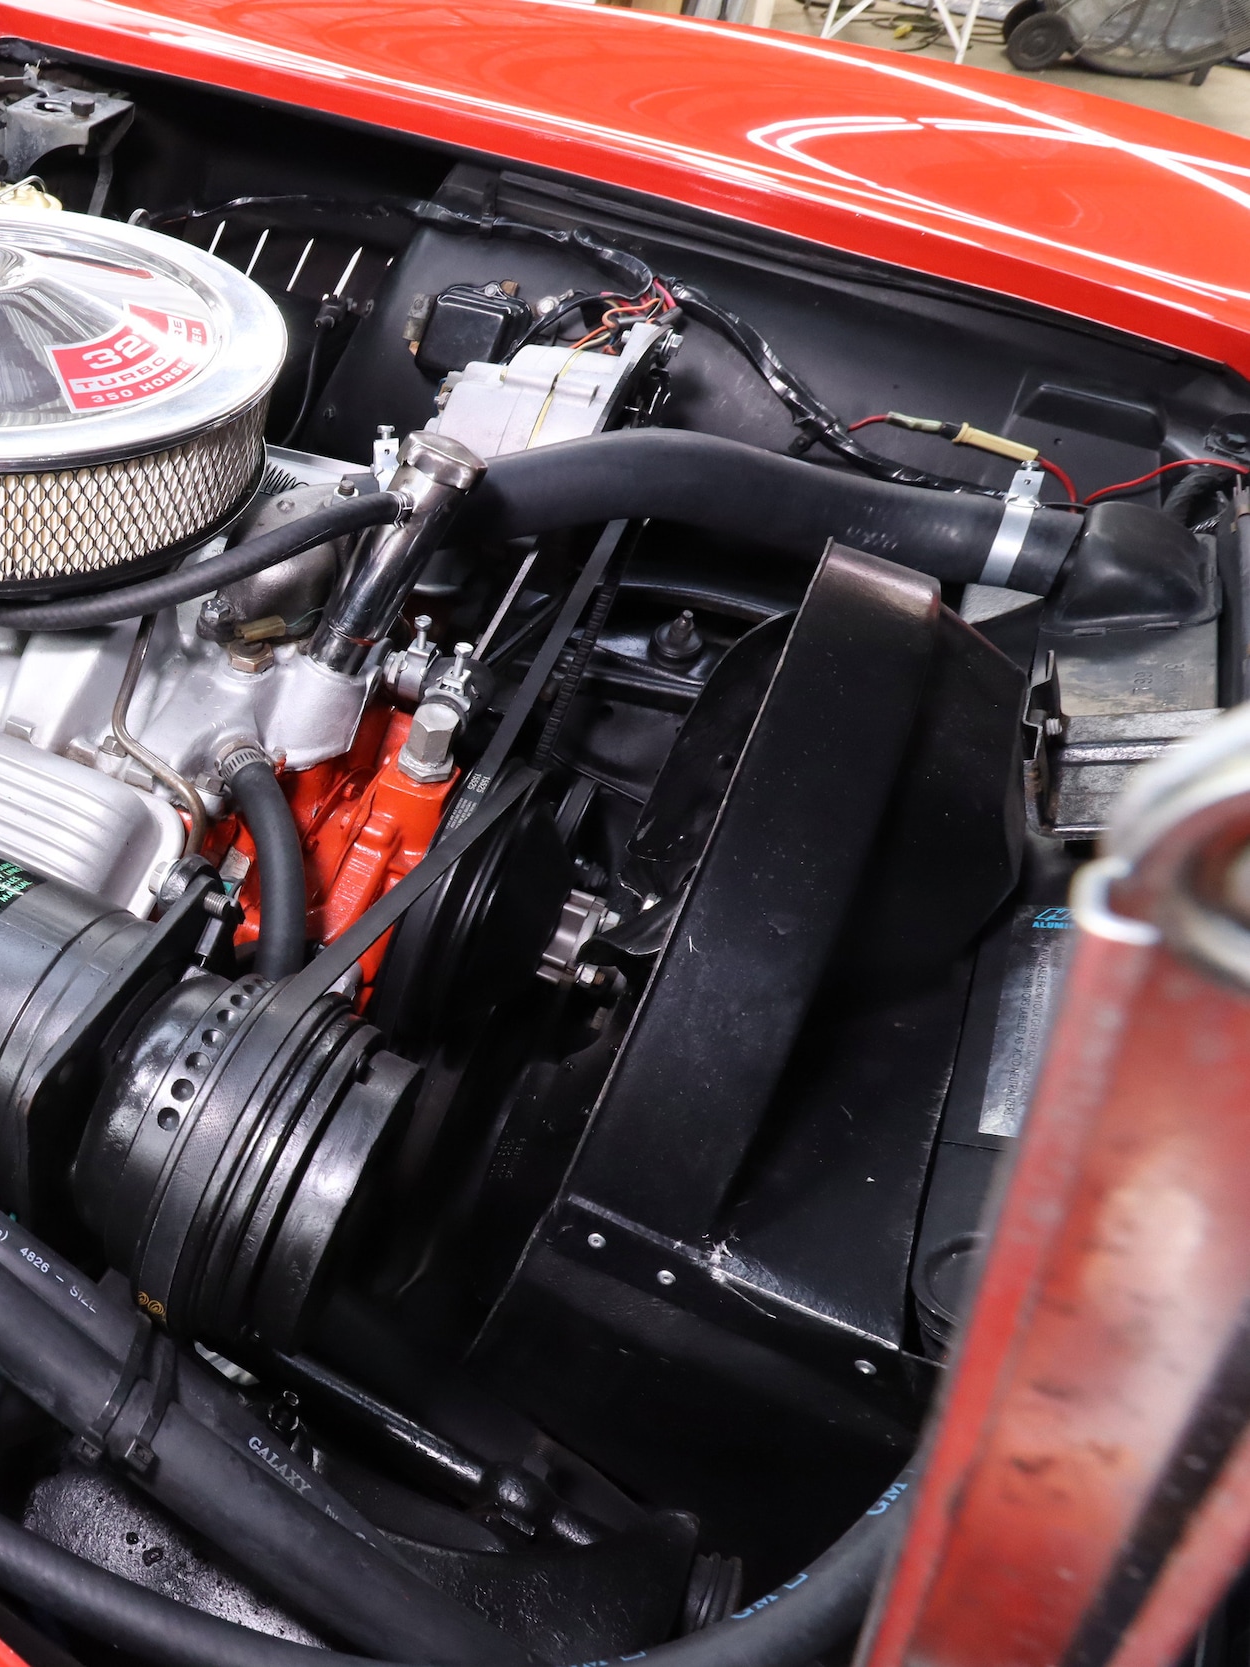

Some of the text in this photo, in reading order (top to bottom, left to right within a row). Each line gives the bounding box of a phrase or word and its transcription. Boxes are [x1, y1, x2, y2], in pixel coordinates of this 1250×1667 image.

[76, 356, 167, 390] TURBO
[90, 388, 134, 404] 350
[19, 1246, 51, 1274] 4826
[248, 1436, 312, 1495] GALAXY
[865, 1482, 909, 1516] GM
